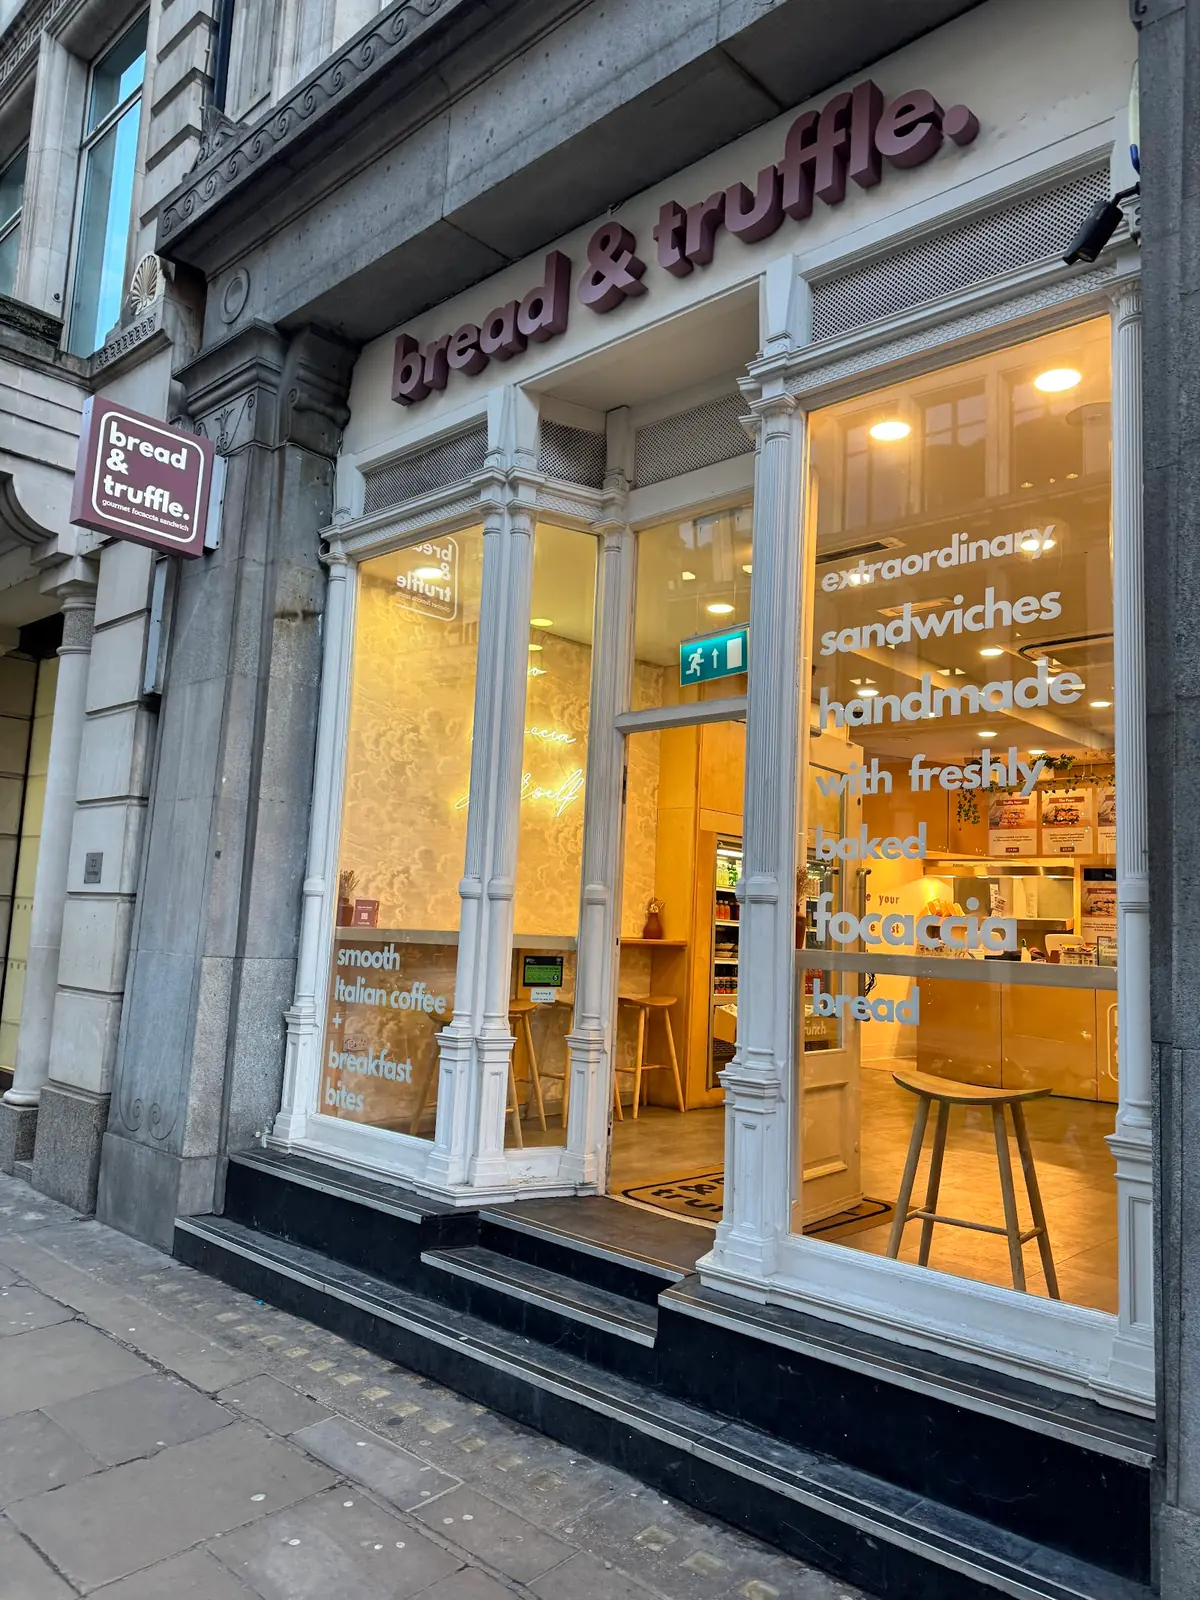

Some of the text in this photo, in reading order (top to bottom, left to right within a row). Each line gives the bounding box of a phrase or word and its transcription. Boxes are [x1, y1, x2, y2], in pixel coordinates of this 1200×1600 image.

[391, 79, 980, 406] bread & truffle.
[105, 448, 129, 475] &
[109, 421, 187, 470] bread
[102, 499, 189, 532] gourmet focaccia sandwich
[103, 475, 190, 521] truffle.
[821, 524, 1056, 592] extraordinary
[819, 587, 1062, 656] sandwiches
[819, 657, 1083, 729] handmade
[815, 746, 1046, 797] with freshly
[815, 822, 927, 861] baked
[813, 891, 1018, 951] focaccia
[879, 894, 900, 906] your
[336, 943, 400, 971] smooth
[334, 975, 447, 1014] Italian coffee
[812, 978, 920, 1025] bread
[332, 1013, 342, 1029] +
[328, 1040, 413, 1085] breakfast
[325, 1077, 364, 1113] bites
